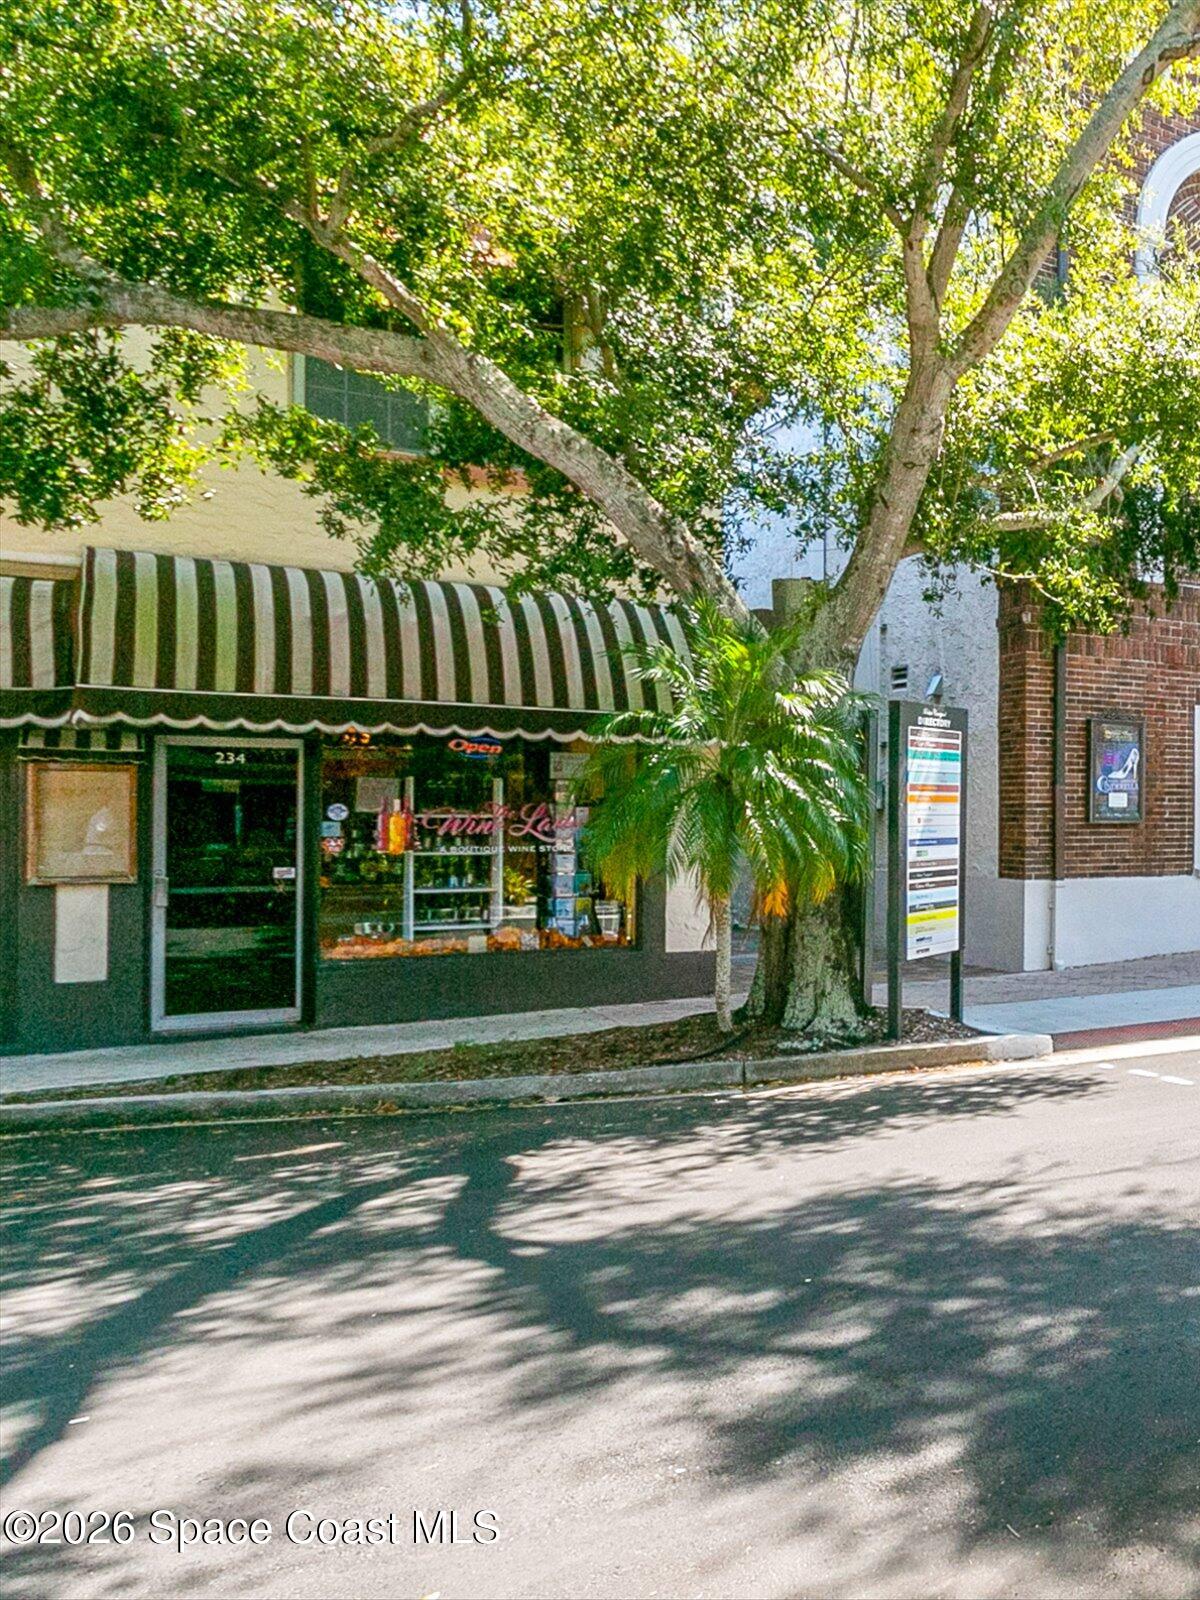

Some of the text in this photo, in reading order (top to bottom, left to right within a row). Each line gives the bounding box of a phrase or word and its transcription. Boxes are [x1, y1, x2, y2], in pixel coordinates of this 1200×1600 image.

[448, 738, 502, 755] Open
[215, 752, 246, 764] 234
[508, 845, 537, 853] WINE
